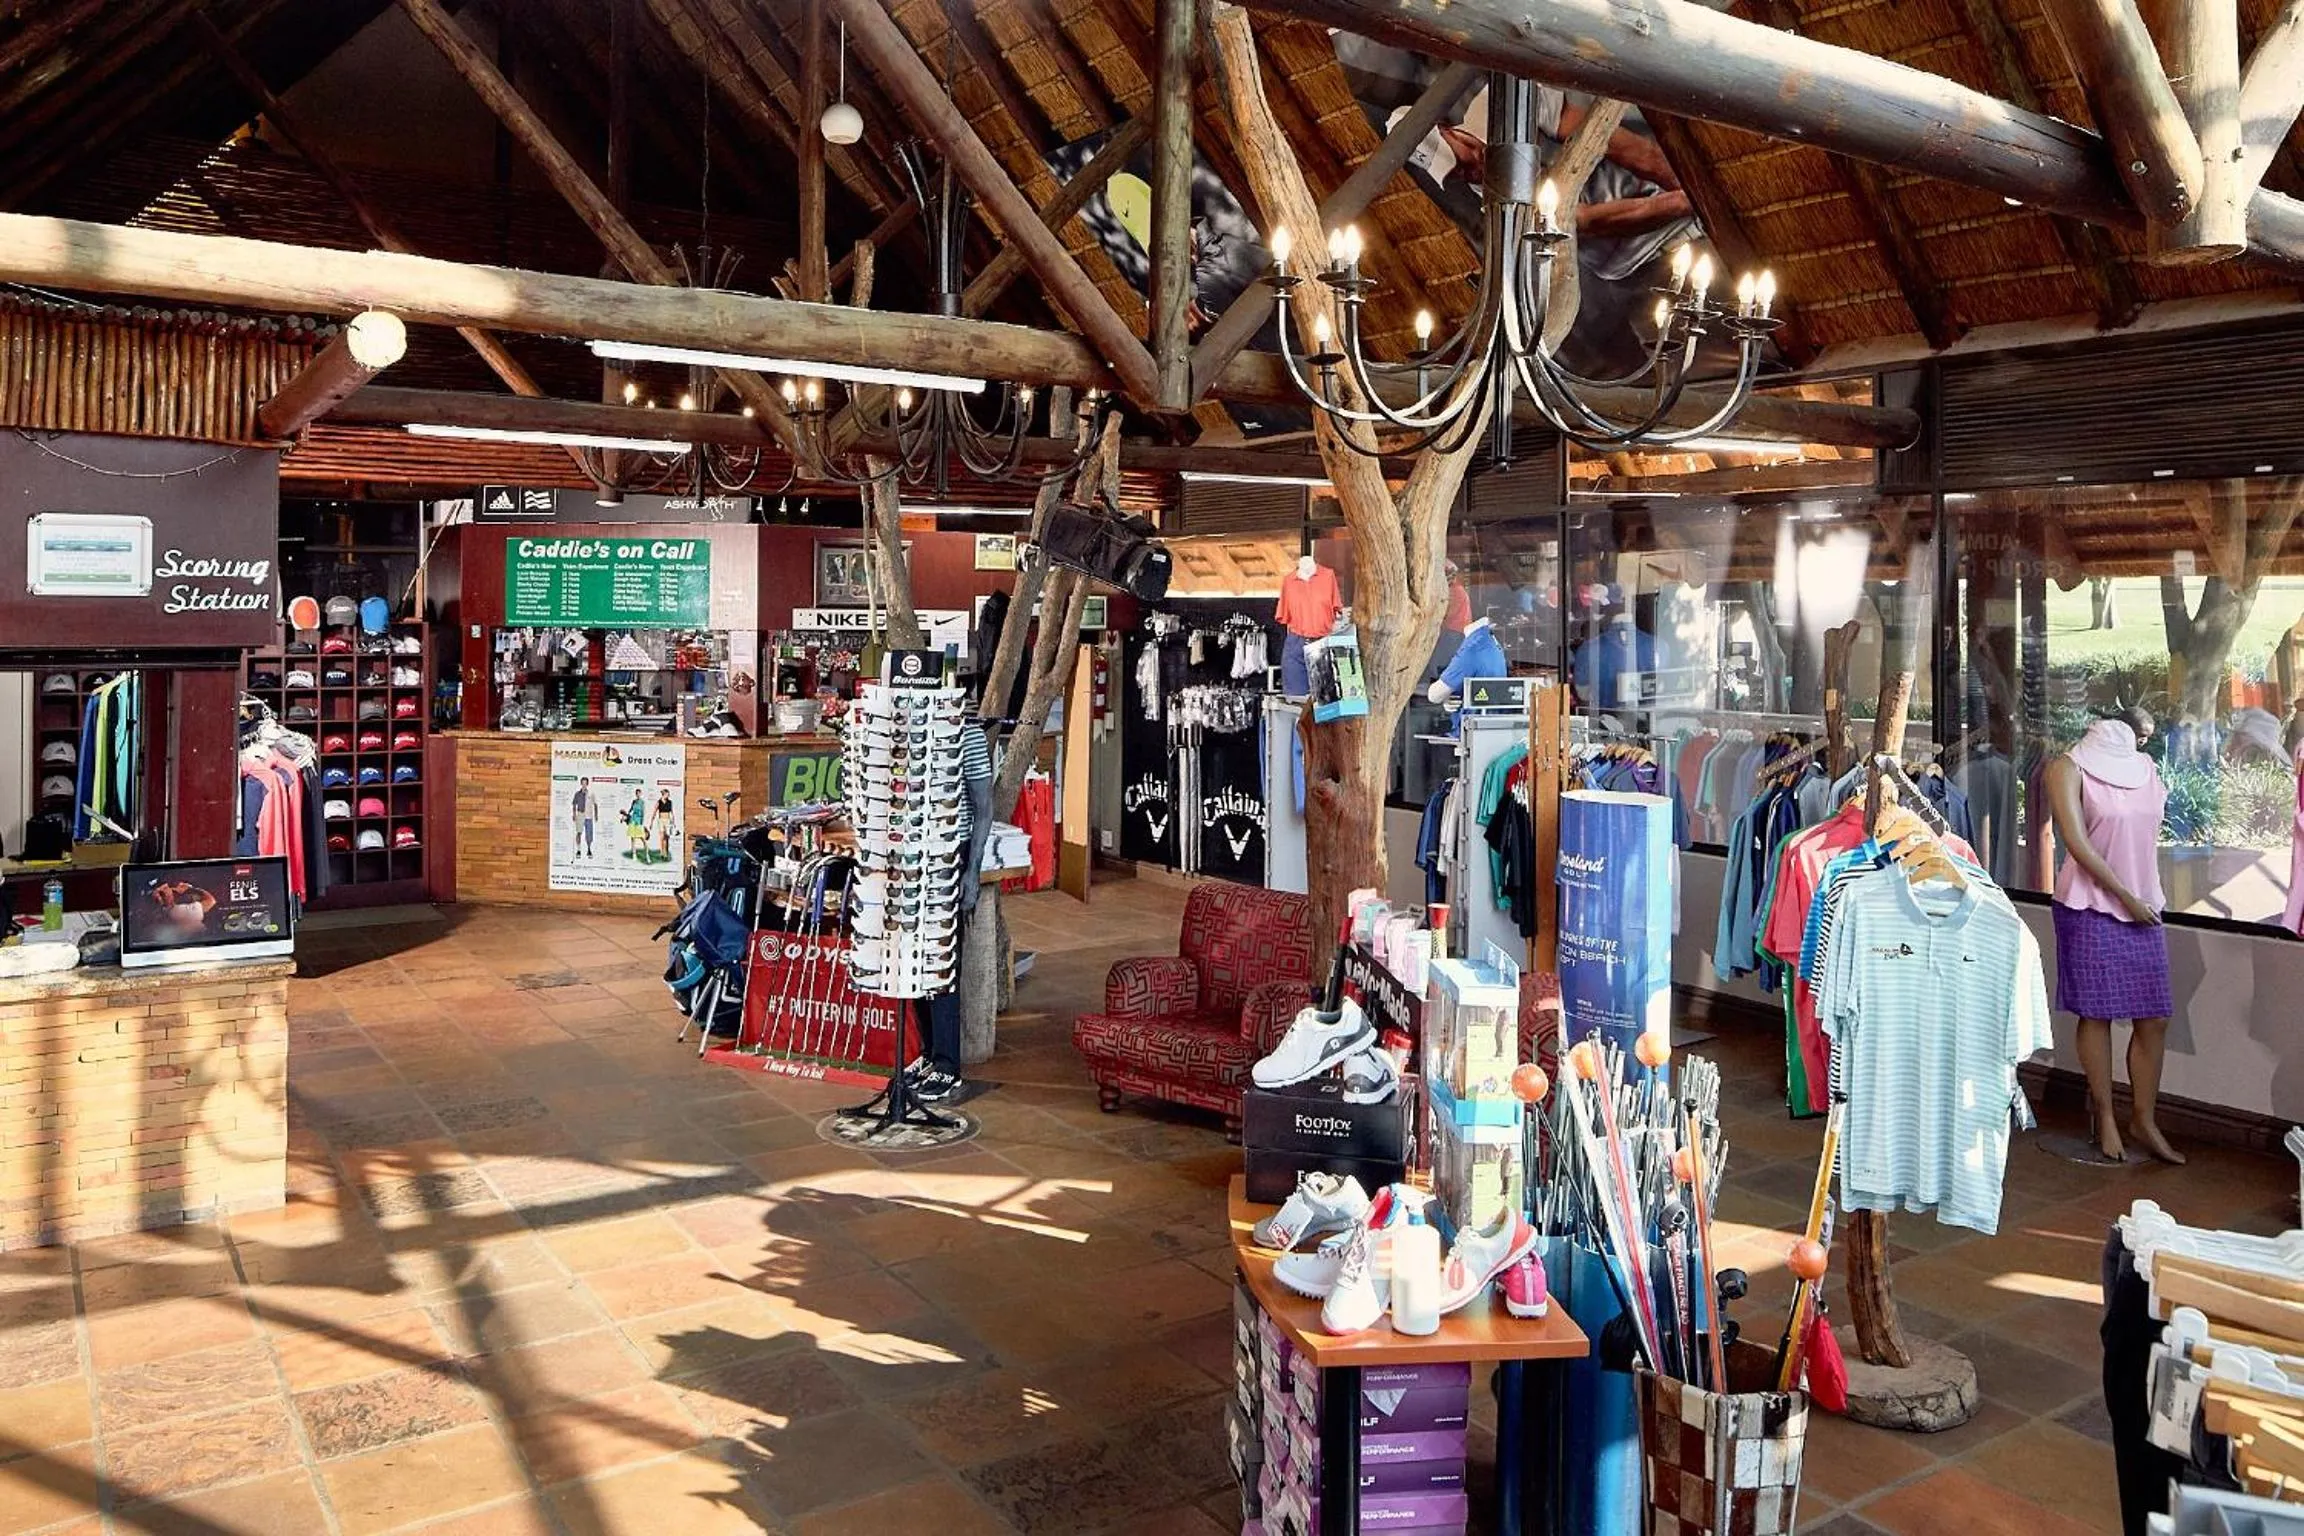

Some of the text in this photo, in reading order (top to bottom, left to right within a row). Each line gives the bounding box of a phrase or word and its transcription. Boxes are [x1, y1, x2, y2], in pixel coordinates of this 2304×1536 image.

[519, 540, 695, 559] Caddie's on Call
[155, 550, 271, 585] Scoring
[164, 584, 270, 614] Station
[816, 613, 869, 627] NIKE
[627, 756, 678, 766] Dress Code
[230, 887, 259, 902] ELS
[789, 997, 840, 1022] PUTTER
[843, 1003, 857, 1026] IN
[1295, 1114, 1352, 1132] FOOTJOY
